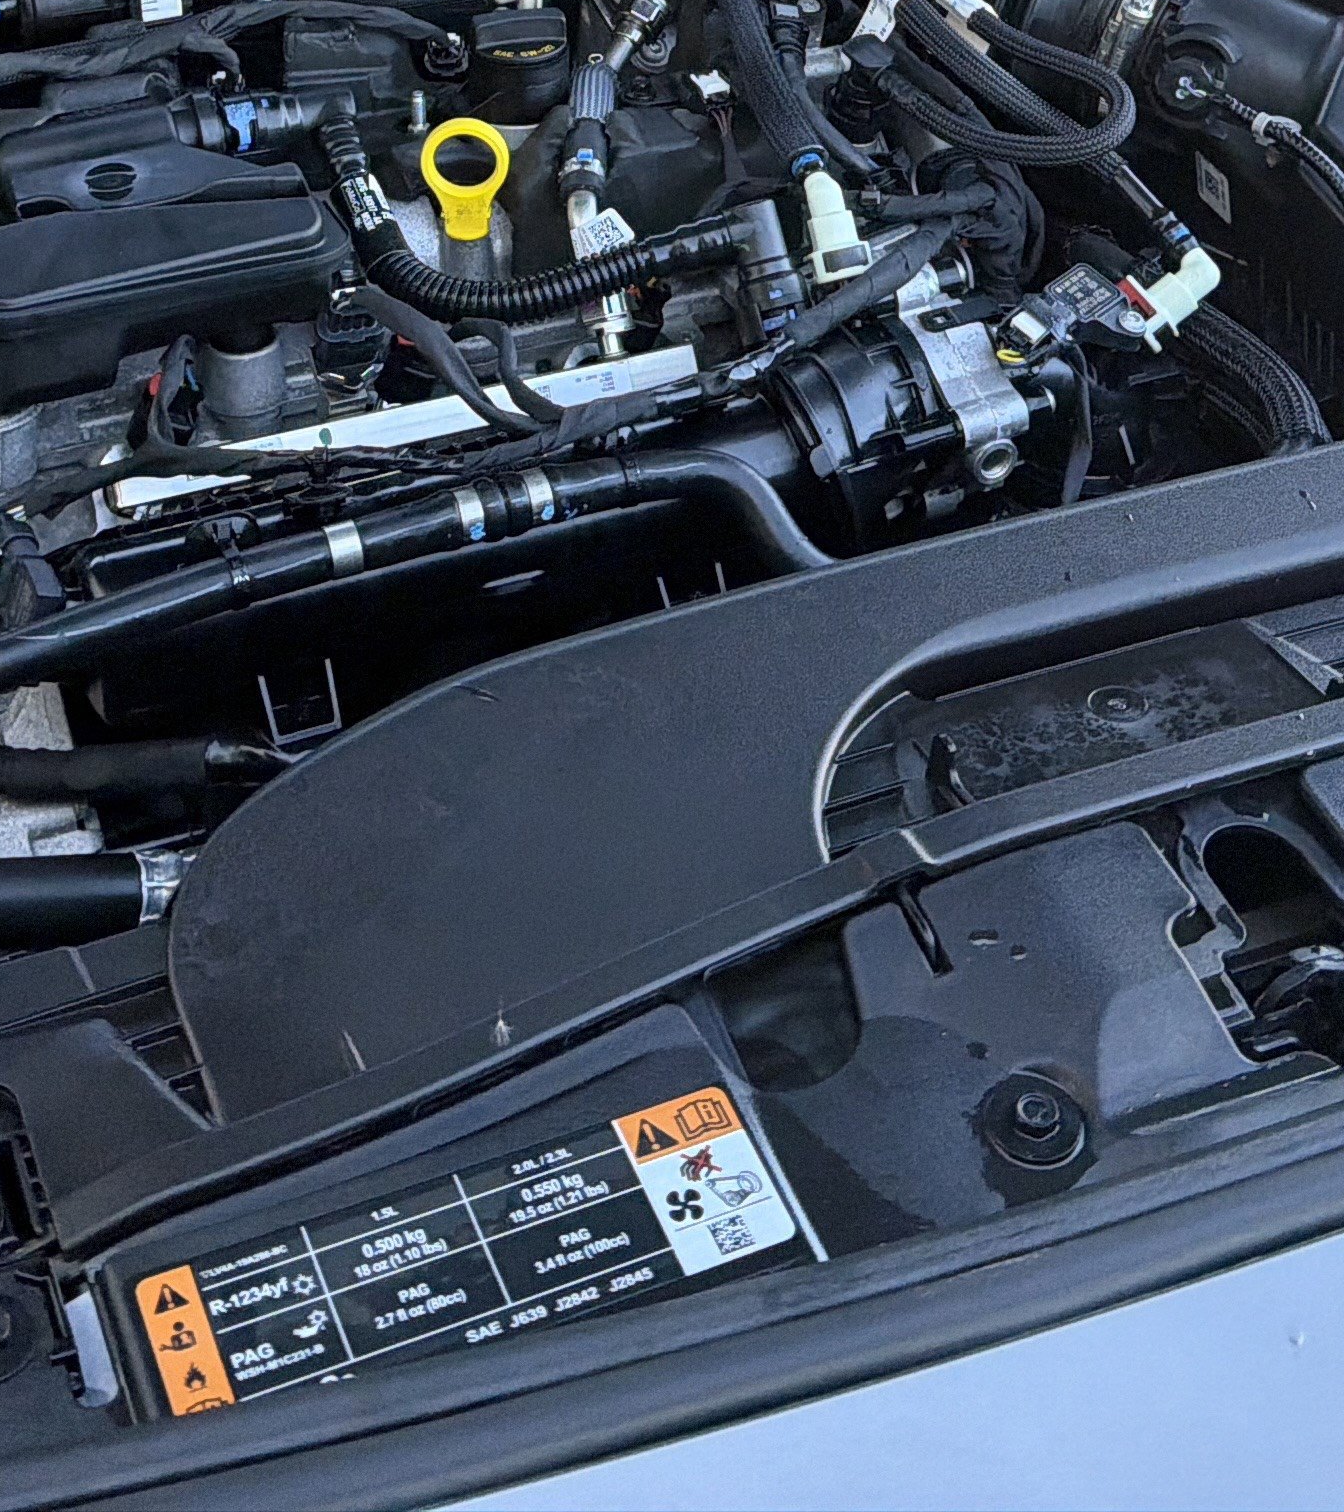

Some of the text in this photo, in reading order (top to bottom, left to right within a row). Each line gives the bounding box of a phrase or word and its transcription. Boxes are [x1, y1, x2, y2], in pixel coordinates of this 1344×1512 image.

[520, 1173, 584, 1202] 0.550 kg
[537, 1202, 555, 1214] oz
[555, 1190, 582, 1210] (1.21
[584, 1181, 610, 1199] lbs)
[371, 1206, 399, 1221] 1.5L
[361, 1228, 427, 1258] 0.500 kg
[559, 1228, 592, 1247] PAG
[567, 1250, 584, 1263] oz
[584, 1232, 631, 1259] (100cc)
[354, 1238, 448, 1278] 18 oz (1.10 lbs)
[208, 1276, 290, 1316] R-1234yf
[398, 1283, 432, 1303] PAG
[464, 1267, 654, 1343] SAE J639 J2842 J2845
[408, 1305, 426, 1318] oz
[230, 1342, 275, 1369] PAG
